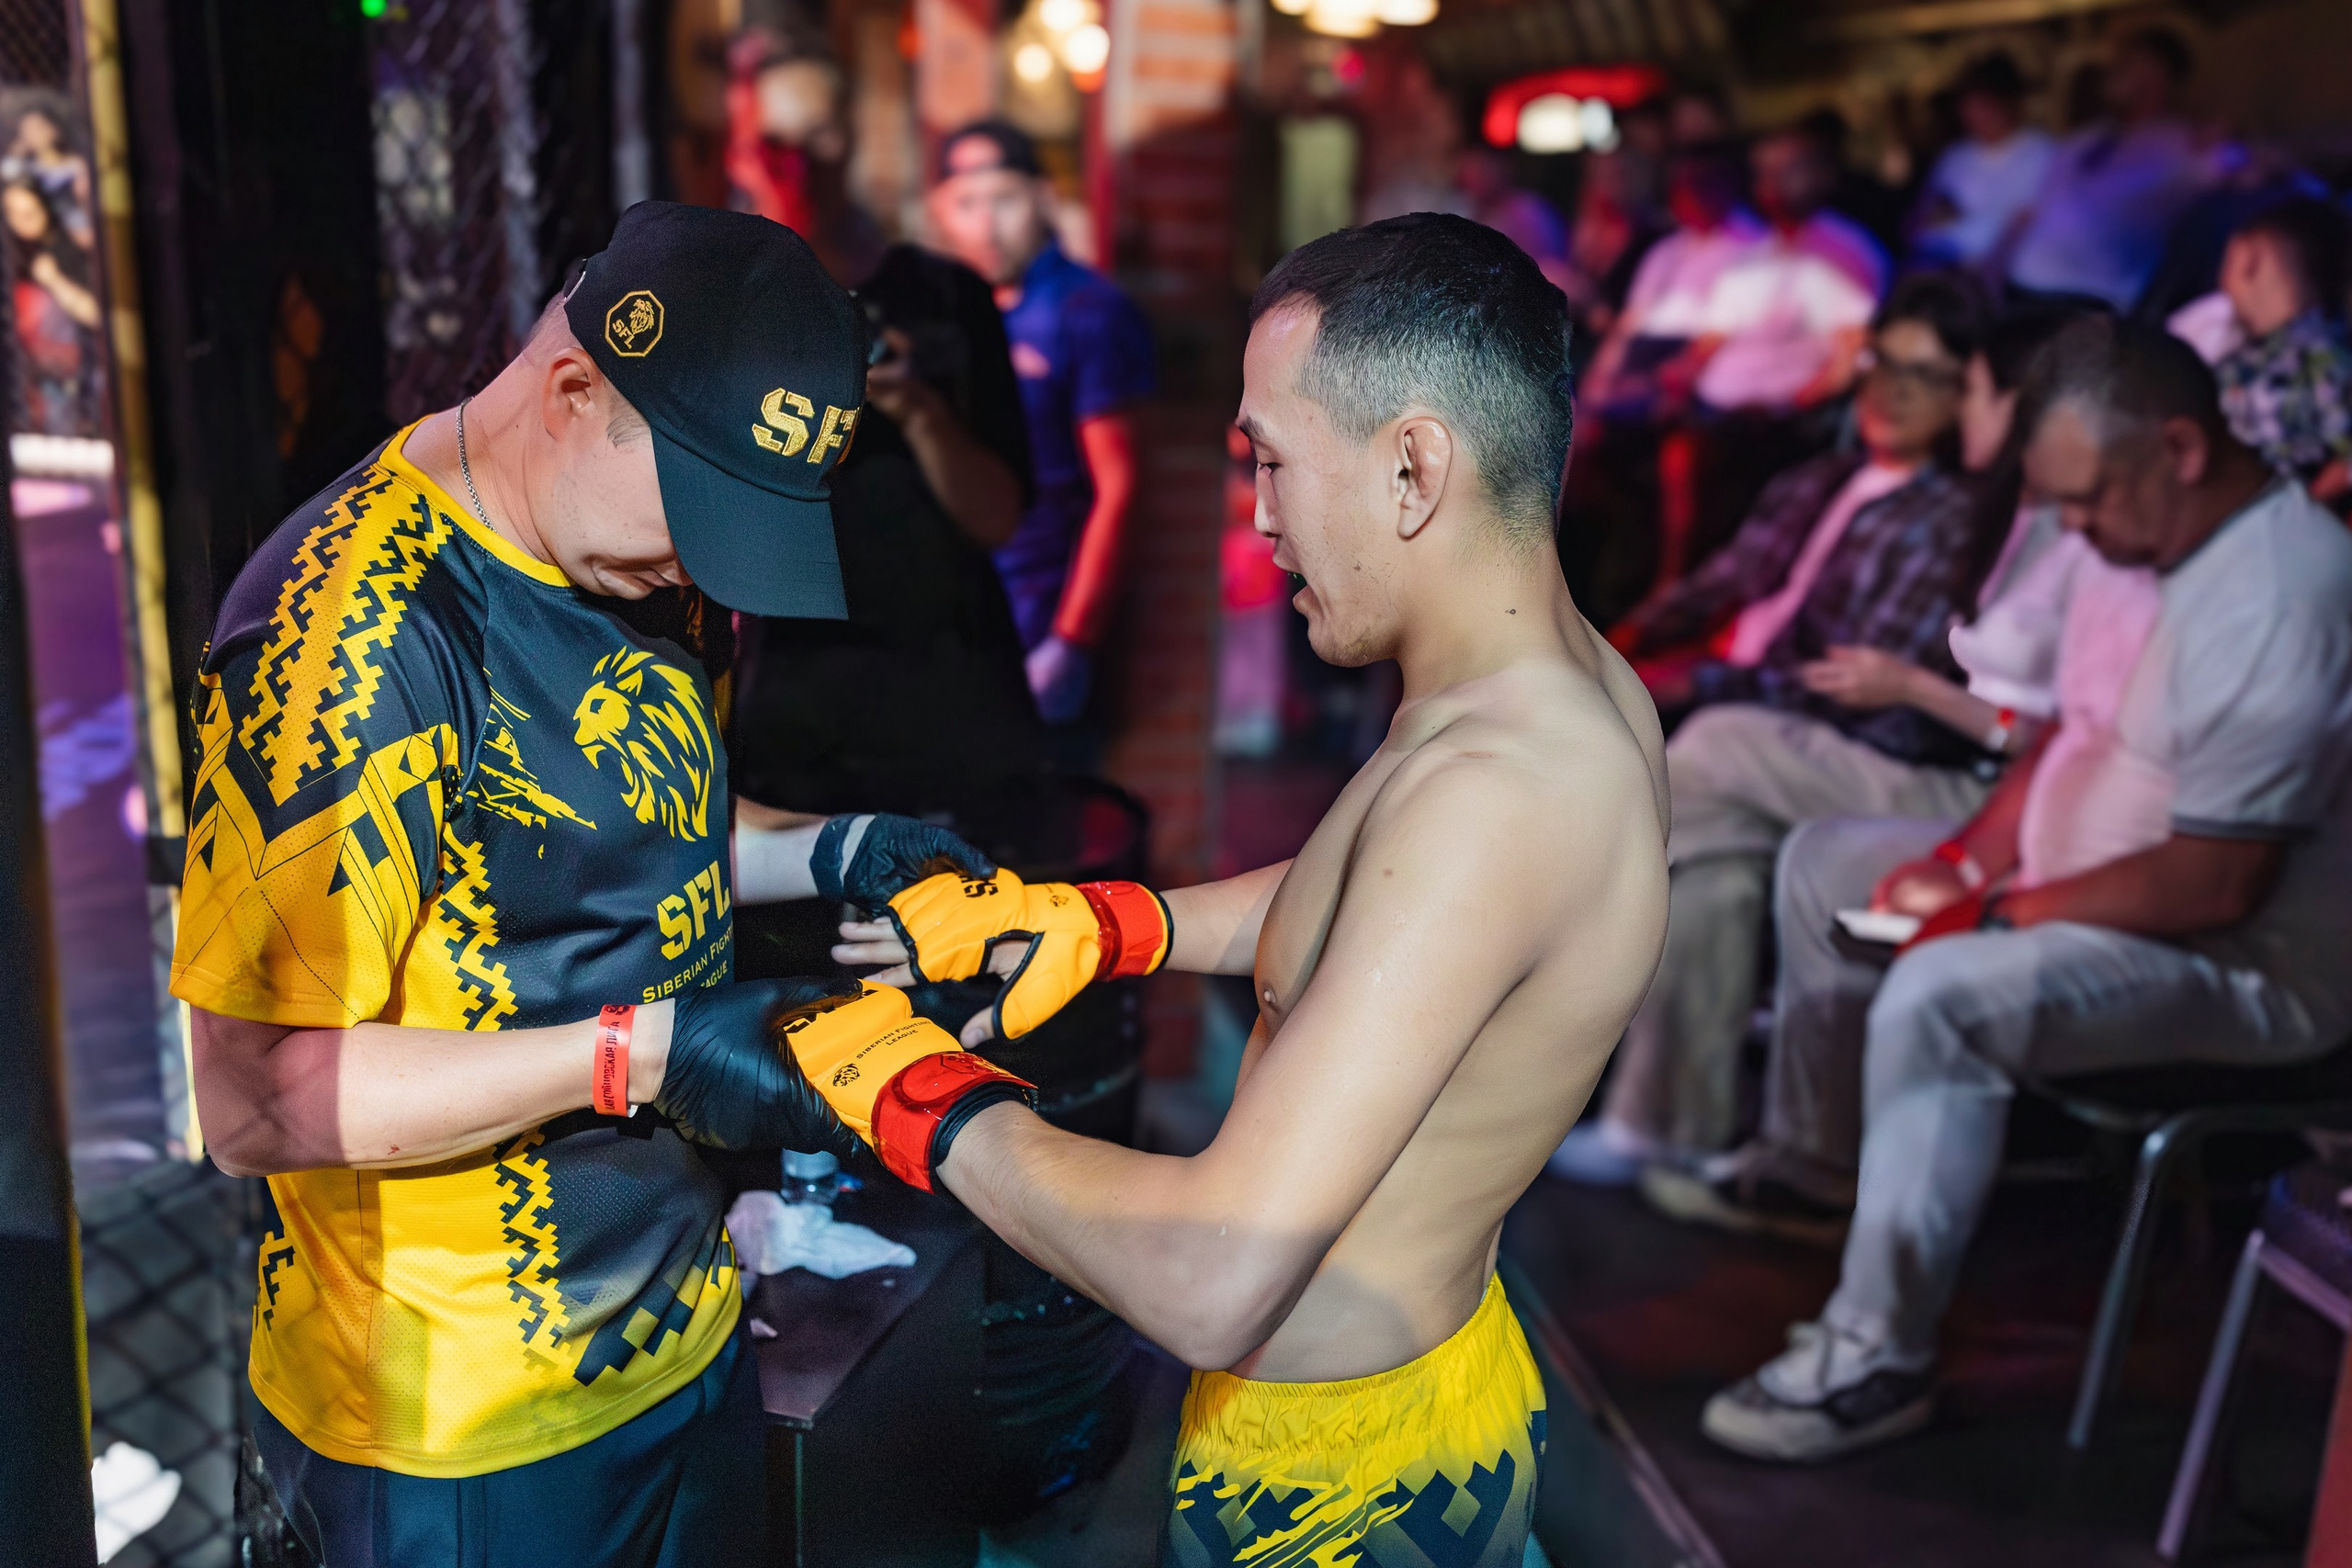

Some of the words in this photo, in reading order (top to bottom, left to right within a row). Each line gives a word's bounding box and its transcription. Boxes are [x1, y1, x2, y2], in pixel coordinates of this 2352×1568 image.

[612, 319, 635, 350] SFL
[752, 388, 860, 464] SF
[656, 860, 730, 961] SFL
[643, 953, 708, 1004] SIBERIAN
[701, 960, 728, 988] AGUE
[856, 1032, 895, 1059] SIBERIAN
[886, 1029, 919, 1045] LEAGUE
